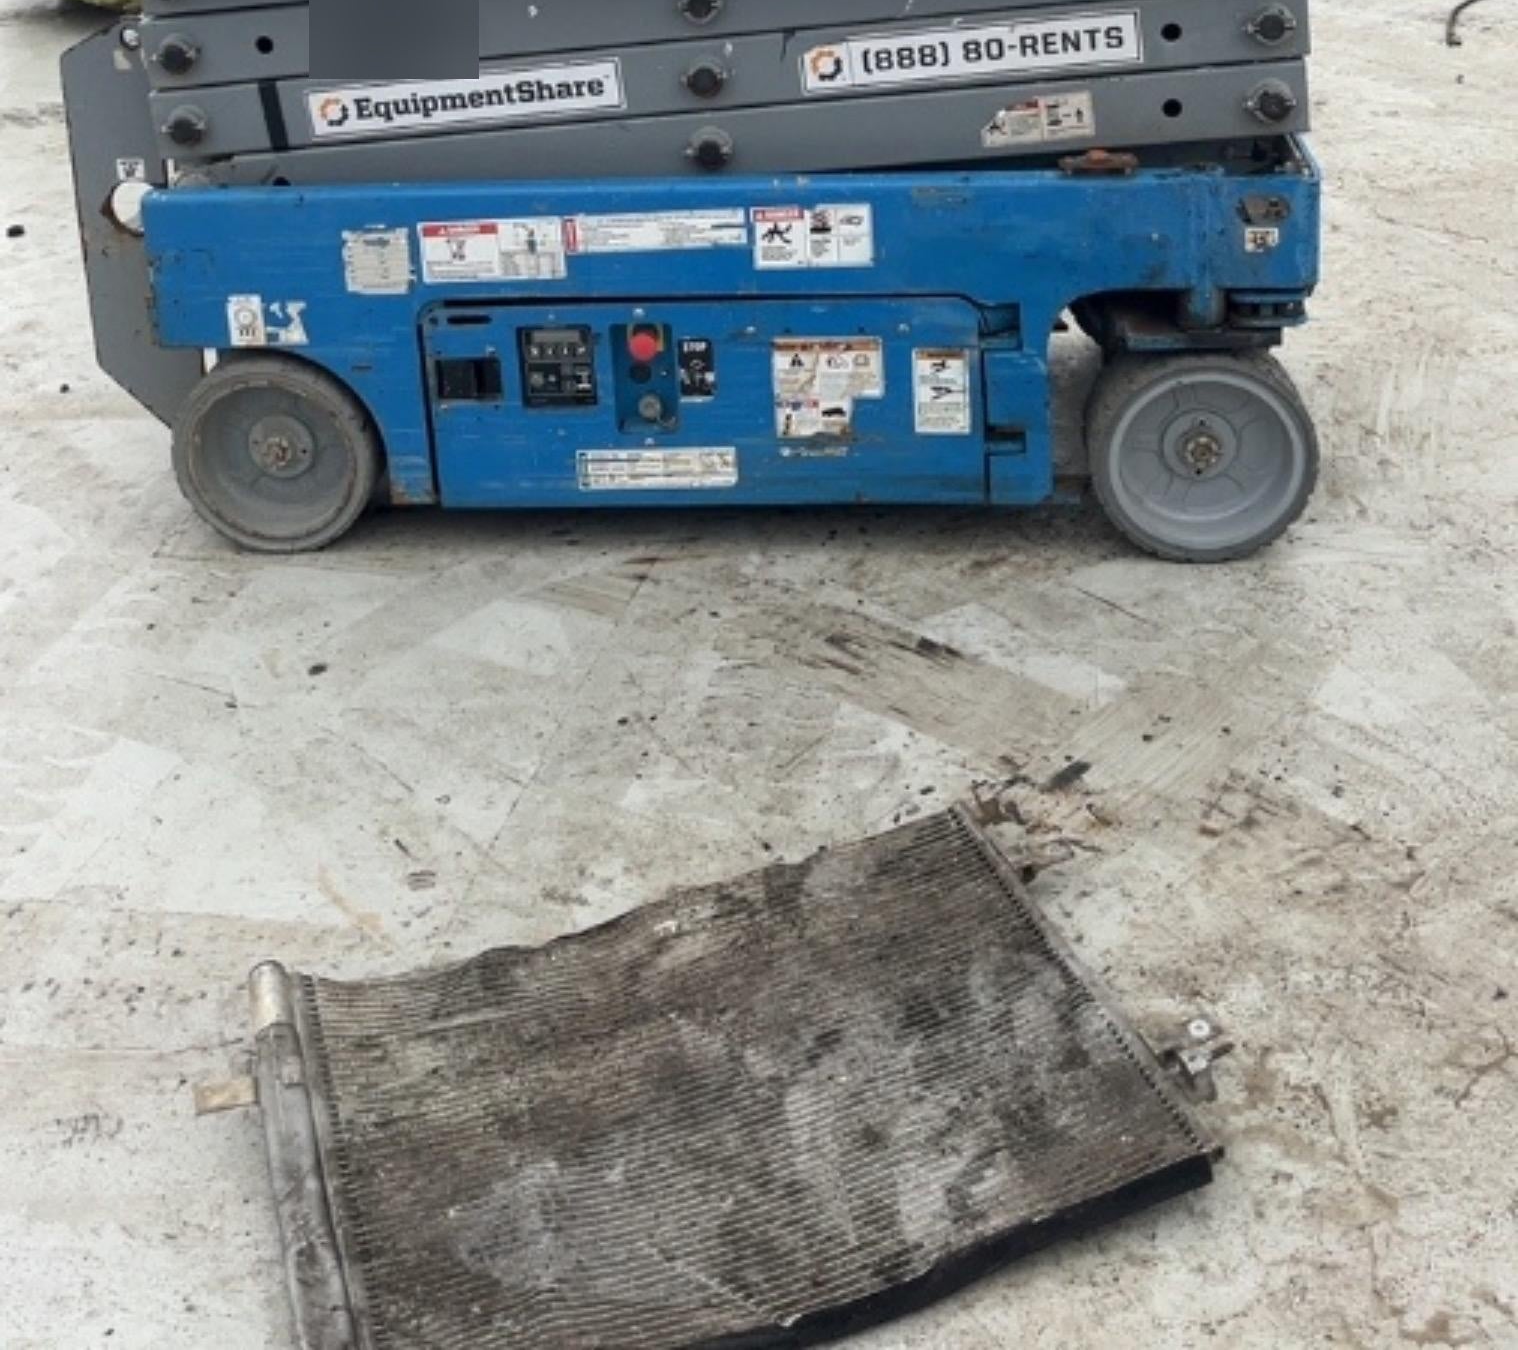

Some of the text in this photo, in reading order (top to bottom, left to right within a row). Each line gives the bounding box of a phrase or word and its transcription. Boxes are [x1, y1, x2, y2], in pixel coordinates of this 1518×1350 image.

[863, 26, 1124, 74] (888) 80-RENTS
[354, 77, 604, 121] EquipmentShare
